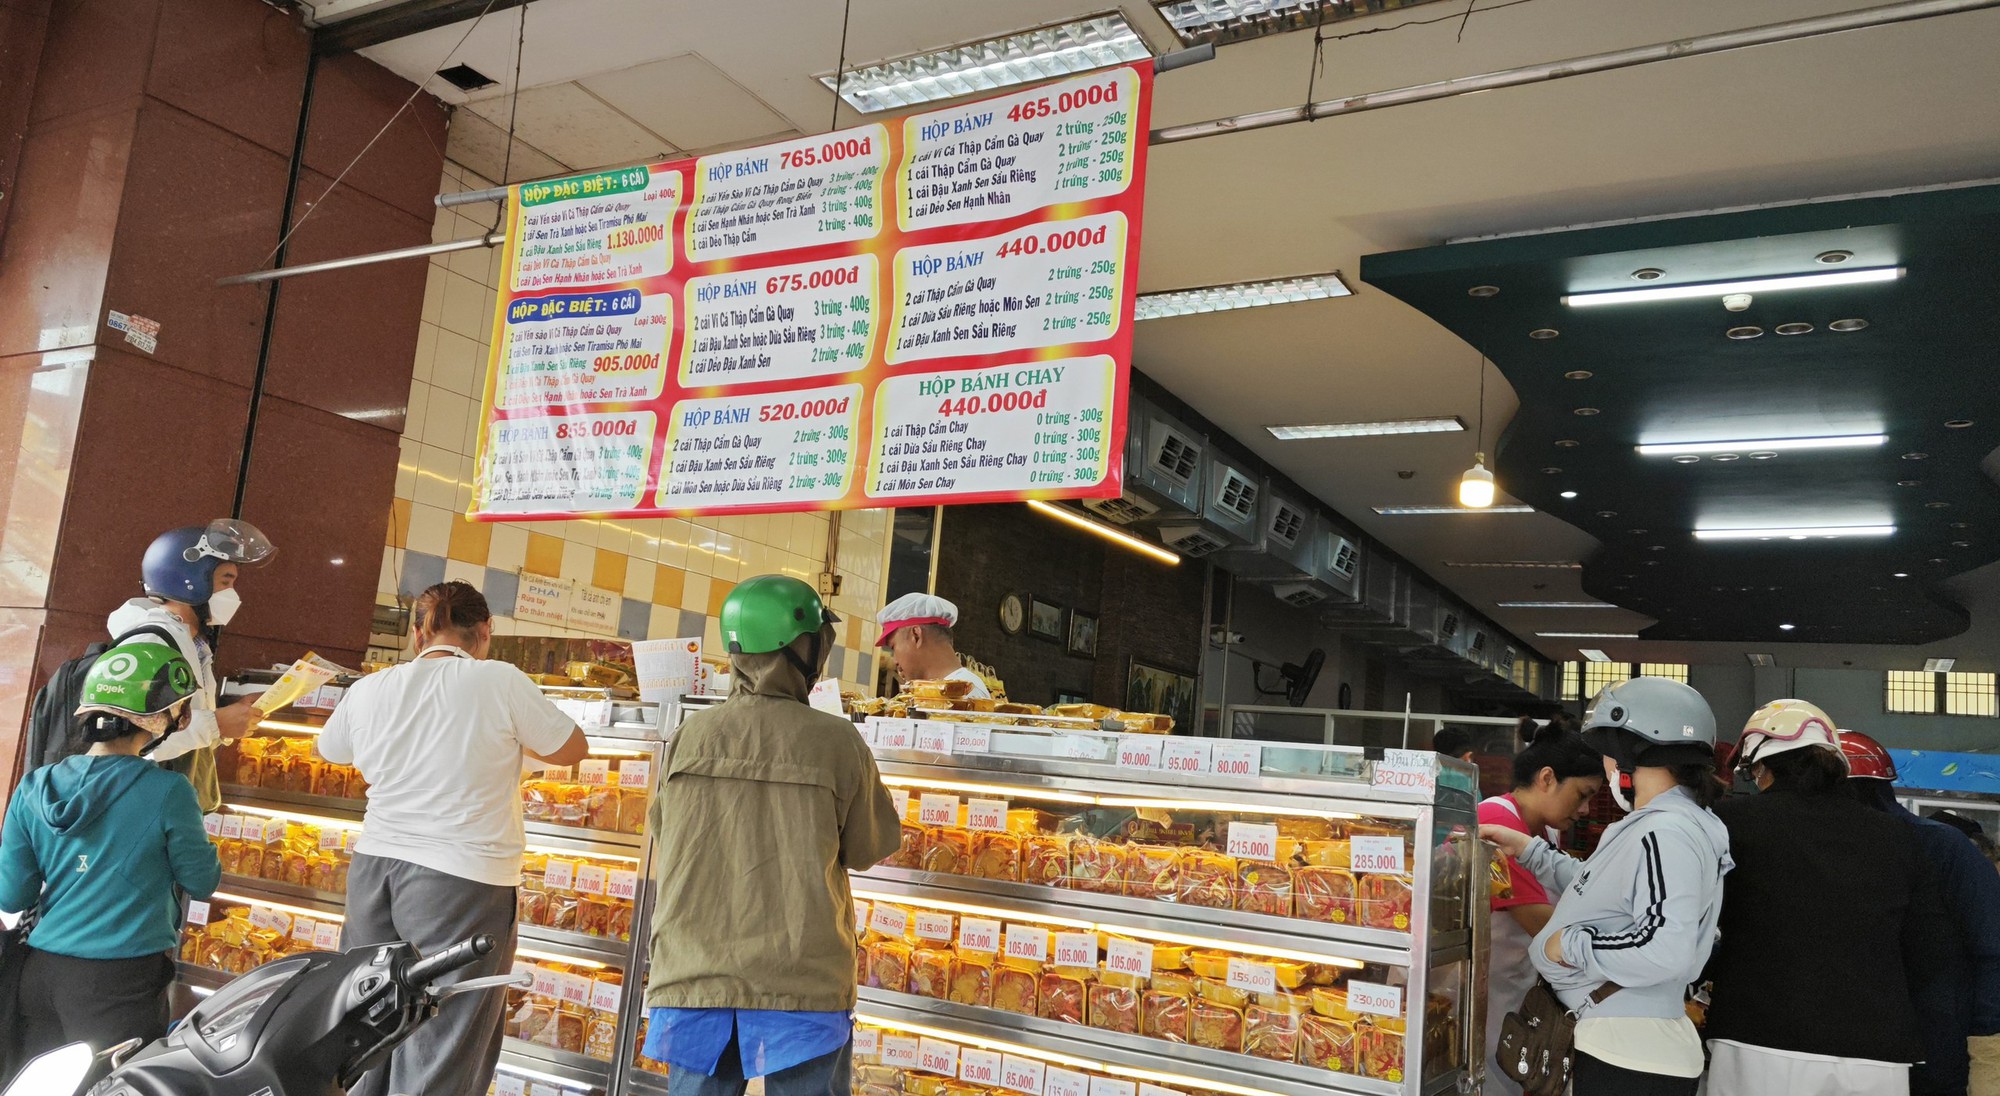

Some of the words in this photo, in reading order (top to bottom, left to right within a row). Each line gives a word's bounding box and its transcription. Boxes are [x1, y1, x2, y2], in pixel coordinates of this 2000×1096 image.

[922, 119, 949, 142] HỘP
[954, 112, 993, 134] BÁNH
[1007, 81, 1118, 123] 465.000đ
[709, 162, 732, 184] HỘP
[736, 157, 769, 177] BÁNH
[780, 137, 871, 169] 765.000đ
[916, 165, 929, 180] cái
[932, 161, 955, 180] Thập
[958, 156, 977, 174] Cẩm
[980, 156, 991, 170] Gà
[995, 154, 1016, 170] Quay
[524, 185, 551, 202] HỘP
[554, 182, 579, 200] ĐẶC
[584, 177, 618, 193] BIỆT:
[622, 174, 627, 188] 6
[630, 171, 644, 187] CÁI
[916, 183, 929, 198] cái
[932, 181, 949, 197] Đậu
[952, 178, 972, 193] Xanh
[975, 175, 989, 189] Sen
[991, 170, 1007, 184] Sầu
[1010, 169, 1036, 184] Riêng
[644, 190, 657, 201] Loại
[659, 188, 676, 199] 400g
[916, 203, 927, 216] cái
[930, 198, 944, 214] Dẻo
[947, 200, 961, 211] Sen
[964, 195, 985, 211] Hạnh
[988, 192, 1010, 205] Nhân
[607, 224, 664, 250] 1.130.000đ
[698, 236, 708, 249] cái
[710, 233, 722, 248] Dẻo
[723, 233, 740, 247] Thập
[742, 228, 756, 243] Cẩm
[913, 255, 941, 279] HỘP
[947, 251, 984, 271] BÁNH
[996, 225, 1106, 259] 440.000đ
[698, 283, 720, 304] HỘP
[724, 279, 756, 298] BÁNH
[766, 266, 859, 294] 675.000đ
[905, 293, 910, 306] 2
[913, 290, 924, 305] cái
[927, 287, 945, 303] Thập
[947, 281, 963, 297] Cẩm
[965, 279, 975, 292] Gà
[977, 277, 996, 291] Quay
[513, 302, 538, 319] HỘP
[542, 299, 565, 317] ĐẶC
[569, 299, 607, 316] BIỆT:
[612, 298, 618, 310] 6
[621, 295, 635, 309] CÁI
[634, 316, 648, 327] Loại
[651, 315, 666, 324] 300g
[701, 313, 710, 328] cái
[720, 310, 729, 326] Cá
[731, 309, 747, 329] Thập
[749, 304, 764, 323] Cẩm
[766, 305, 775, 321] Gà
[777, 304, 794, 322] Quay
[593, 353, 660, 372] 905.000đ
[919, 375, 955, 397] HỘP
[961, 372, 1009, 393] BÁNH
[1015, 366, 1065, 387] CHAY
[938, 389, 1047, 417] 440.000đ
[683, 407, 710, 429] HỘP
[714, 405, 750, 424] BÁNH
[759, 397, 850, 422] 520.000đ
[891, 423, 903, 438] cái
[906, 423, 926, 439] Thập
[929, 420, 946, 435] Cẩm
[949, 421, 968, 435] Chay
[673, 439, 678, 451] 2
[680, 438, 691, 451] cái
[695, 438, 711, 453] Thập
[714, 433, 730, 449] Cẩm
[732, 435, 741, 448] Gà
[744, 435, 762, 448] Quay
[888, 442, 900, 456] cái
[904, 440, 920, 455] Dừa
[922, 439, 937, 453] Sầu
[940, 438, 963, 453] Riêng
[965, 438, 987, 451] Chay
[887, 459, 898, 473] cái
[901, 457, 917, 474] Đậu
[920, 457, 940, 471] Xanh
[943, 455, 957, 469] Sen
[960, 453, 976, 468] Sầu
[979, 453, 1004, 469] Riêng
[1006, 452, 1027, 466] Chay
[883, 477, 895, 491] cái
[898, 475, 915, 490] Môn
[918, 476, 933, 489] Sen
[936, 475, 956, 489] Chay
[536, 598, 547, 606] tay
[547, 611, 563, 621] nhiệt
[96, 684, 126, 694] gojek
[1122, 752, 1150, 766] 90.000
[1168, 756, 1198, 771] 95.000
[1217, 760, 1248, 774] 80.000
[922, 809, 949, 822] 135.000
[970, 815, 997, 828] 135.000
[1229, 839, 1269, 857] 215.000
[1354, 854, 1396, 870] 285.000
[875, 914, 902, 929] 115,000
[918, 922, 948, 933] 115,000
[963, 933, 990, 948] 105.000
[1008, 941, 1036, 956] 105.000
[1058, 948, 1087, 963] 105.000
[1111, 955, 1141, 972] 105.000
[1232, 971, 1270, 986] 155,000
[1353, 994, 1395, 1009] 230,000
[923, 1053, 948, 1071] 85.000
[965, 1064, 991, 1081] 85.000
[1005, 1072, 1034, 1090] 85.000
